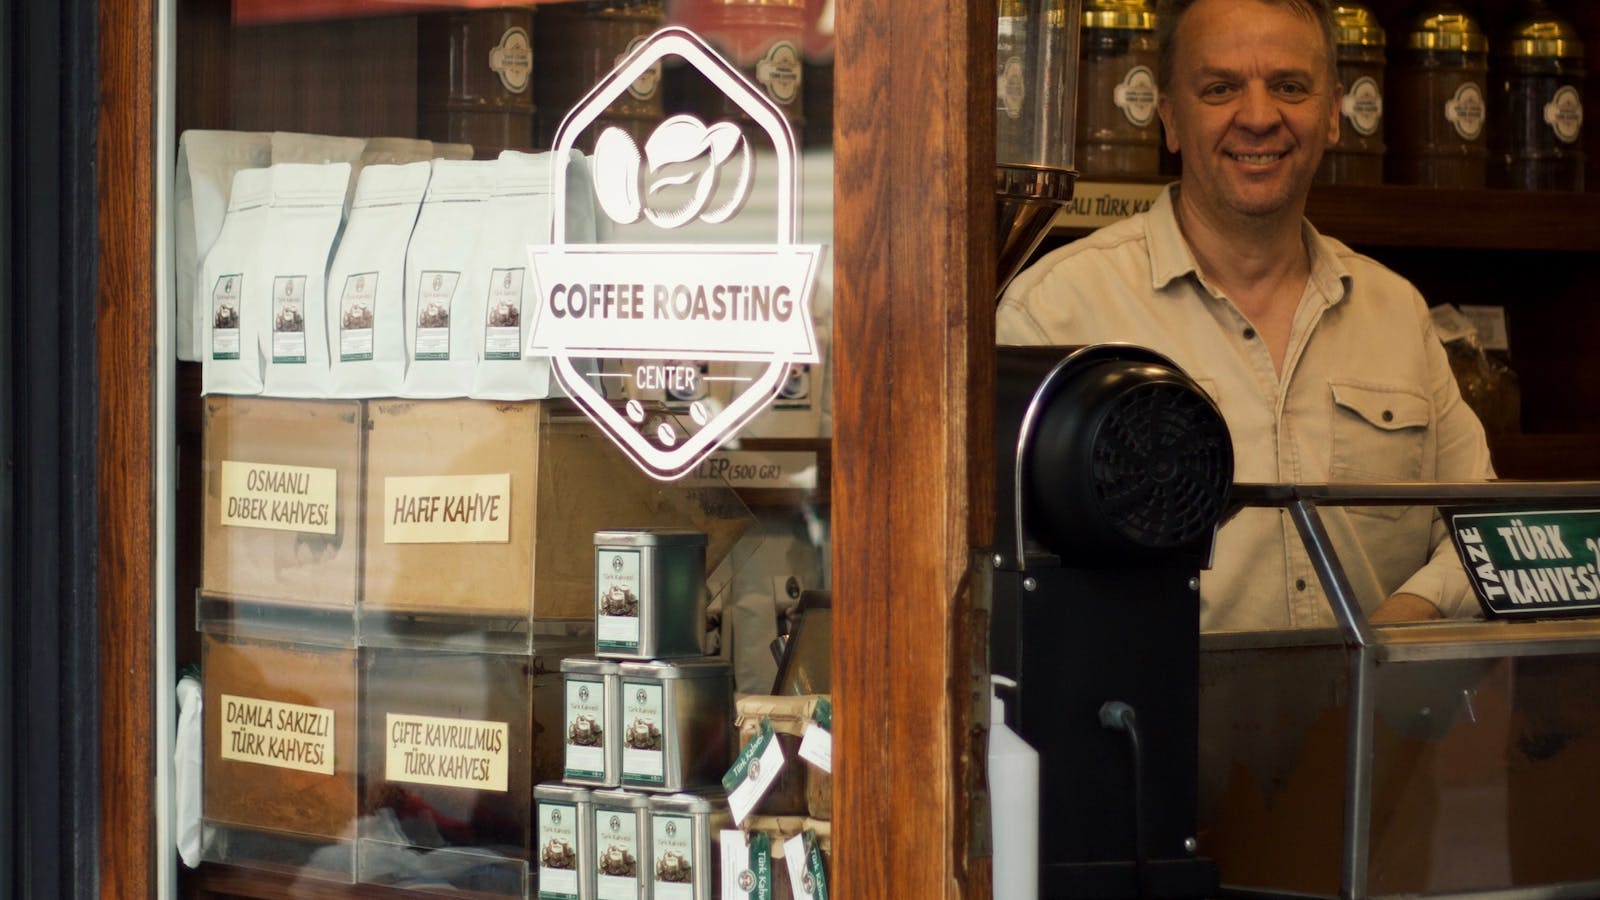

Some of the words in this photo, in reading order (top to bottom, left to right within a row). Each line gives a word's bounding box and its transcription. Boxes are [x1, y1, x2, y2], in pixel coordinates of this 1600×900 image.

[1066, 198, 1091, 215] ALI
[1096, 194, 1129, 216] TÜRK
[1133, 199, 1155, 213] KA
[550, 283, 644, 319] COFFEE
[636, 365, 695, 391] CENTER
[247, 469, 310, 495] OSMANLI
[695, 458, 730, 479] LEP
[728, 464, 757, 480] (500
[760, 464, 781, 479] GR)
[442, 493, 501, 524] KAHVE
[1497, 519, 1573, 560] TÜRK
[1460, 527, 1505, 600] TAZE
[227, 701, 273, 729] DAMLA
[277, 709, 329, 737] SAKIZLI
[231, 727, 265, 756] TÜRK
[425, 723, 502, 755] KAVRULMUŞ
[404, 747, 436, 777] TÜRK
[758, 850, 766, 873] Türk
